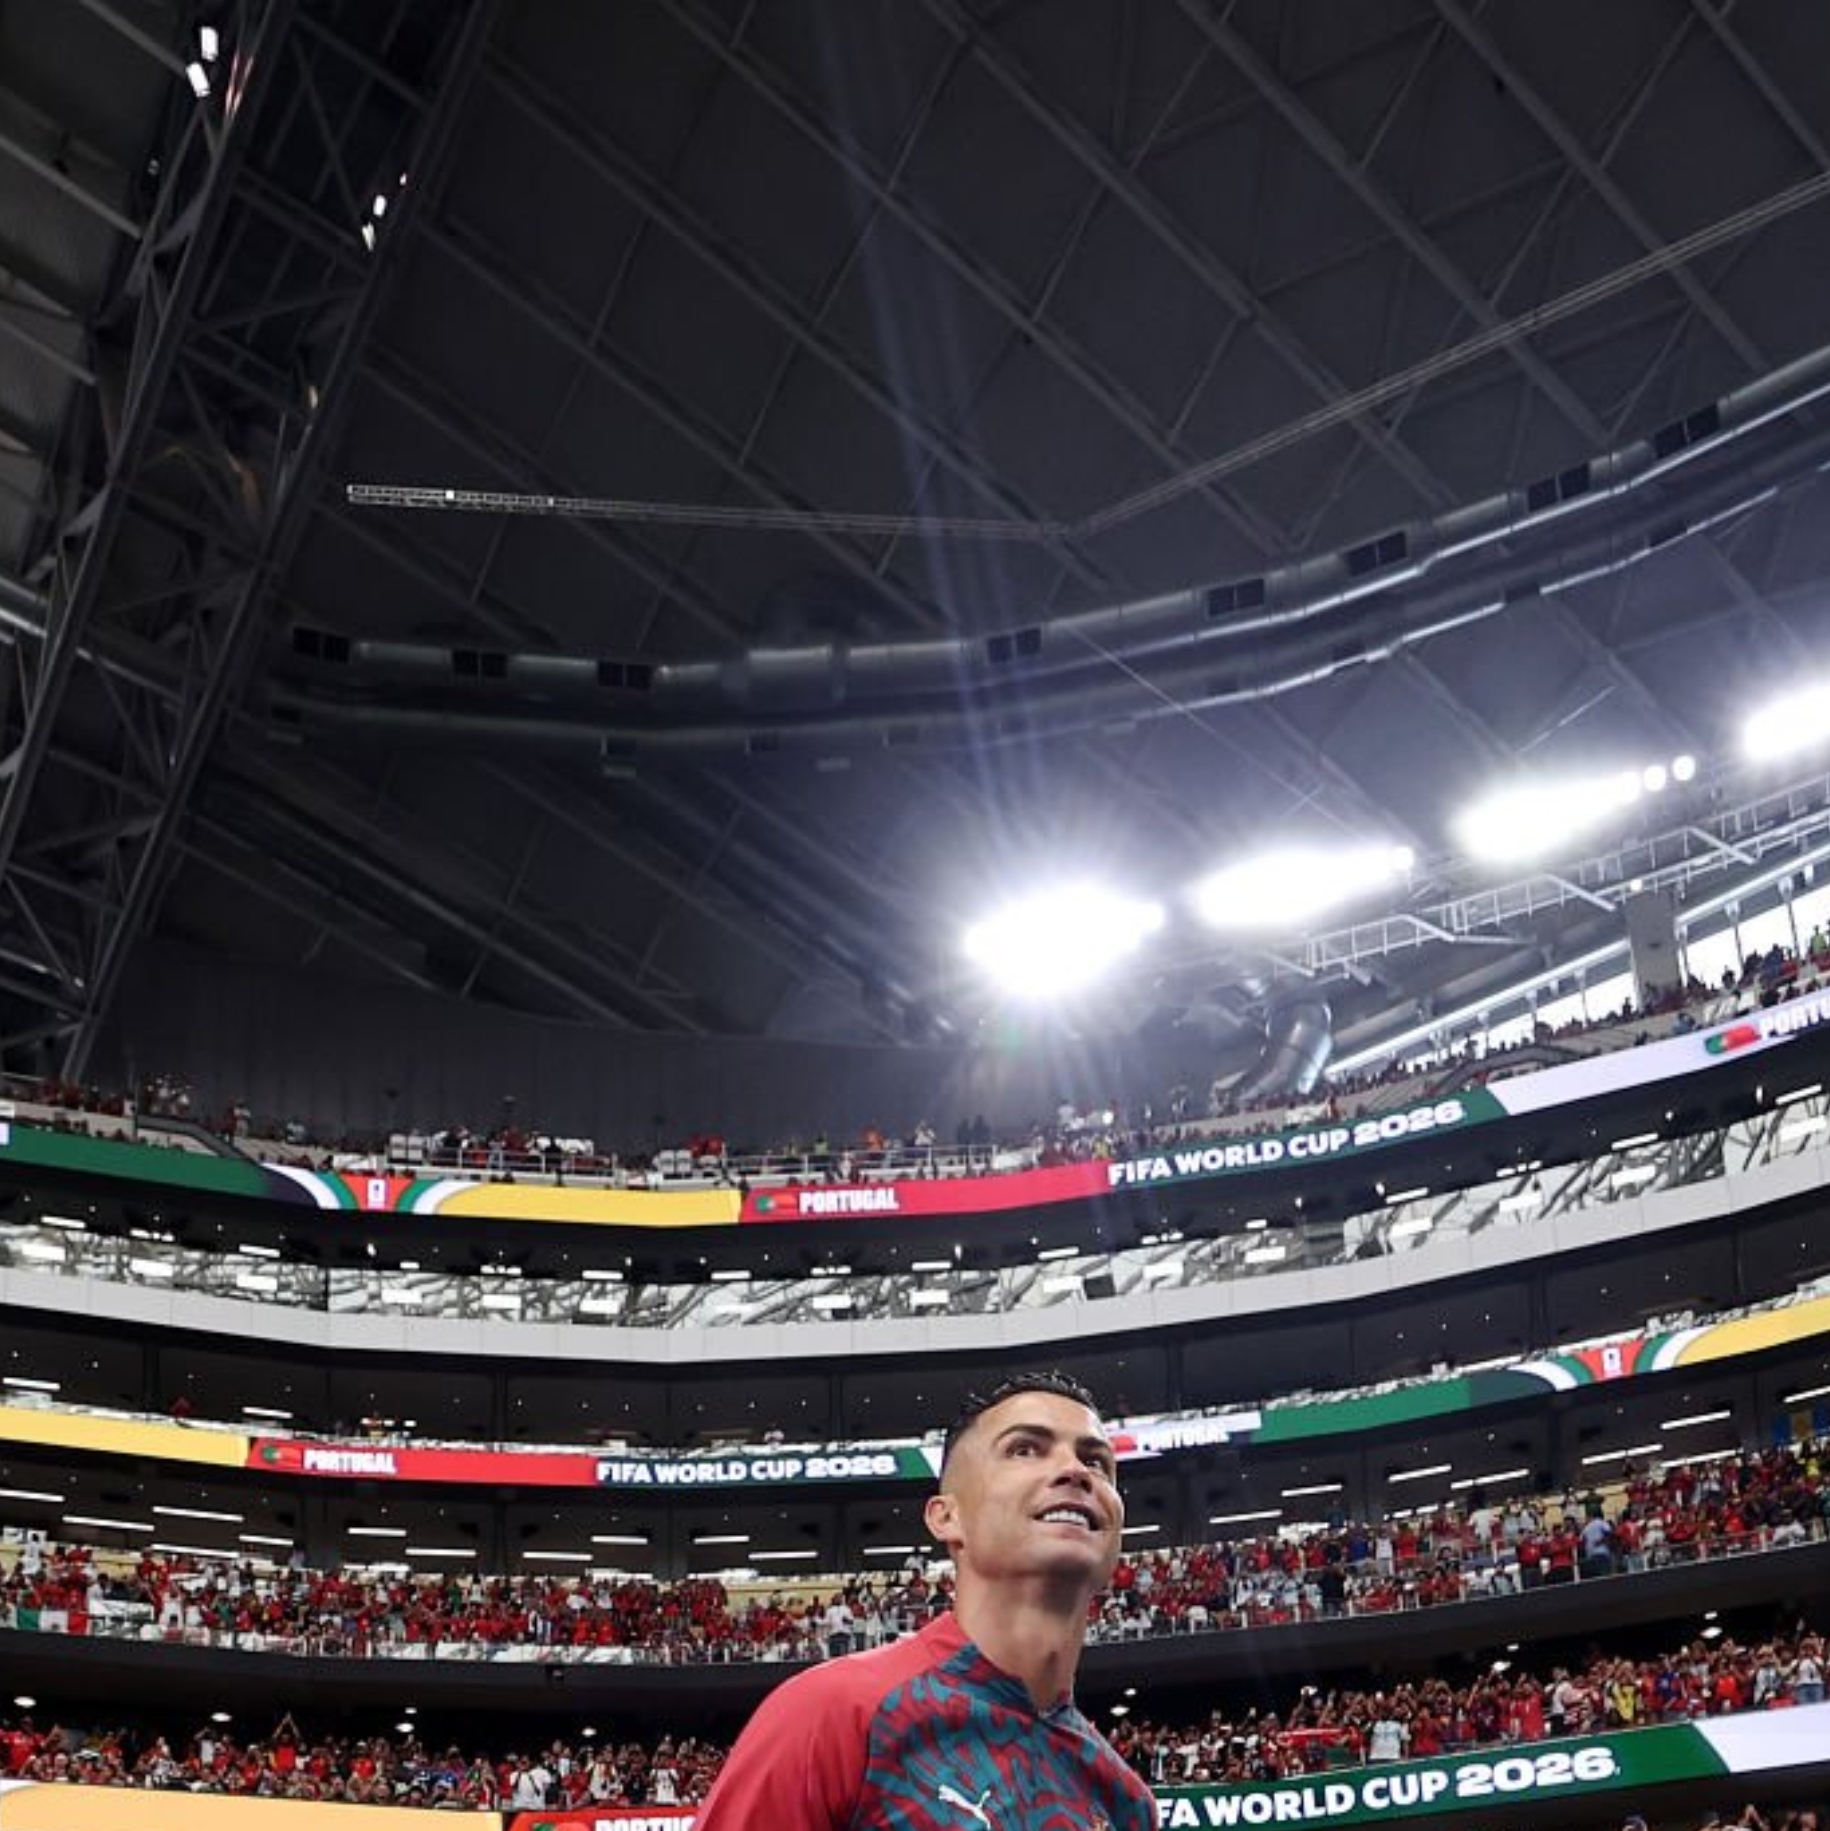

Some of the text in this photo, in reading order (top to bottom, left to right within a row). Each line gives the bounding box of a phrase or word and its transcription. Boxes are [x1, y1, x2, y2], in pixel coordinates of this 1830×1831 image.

[1108, 1102, 1463, 1186] FIFA WORLD CUP 2026
[799, 1187, 899, 1213] PORTUGAL
[305, 1449, 396, 1473] PORTUGAL
[597, 1455, 894, 1483] FIFA WORLD CUP 2026
[1202, 1778, 1355, 1827] WORLD
[1362, 1768, 1450, 1810] CUP
[1456, 1746, 1613, 1797] 2026
